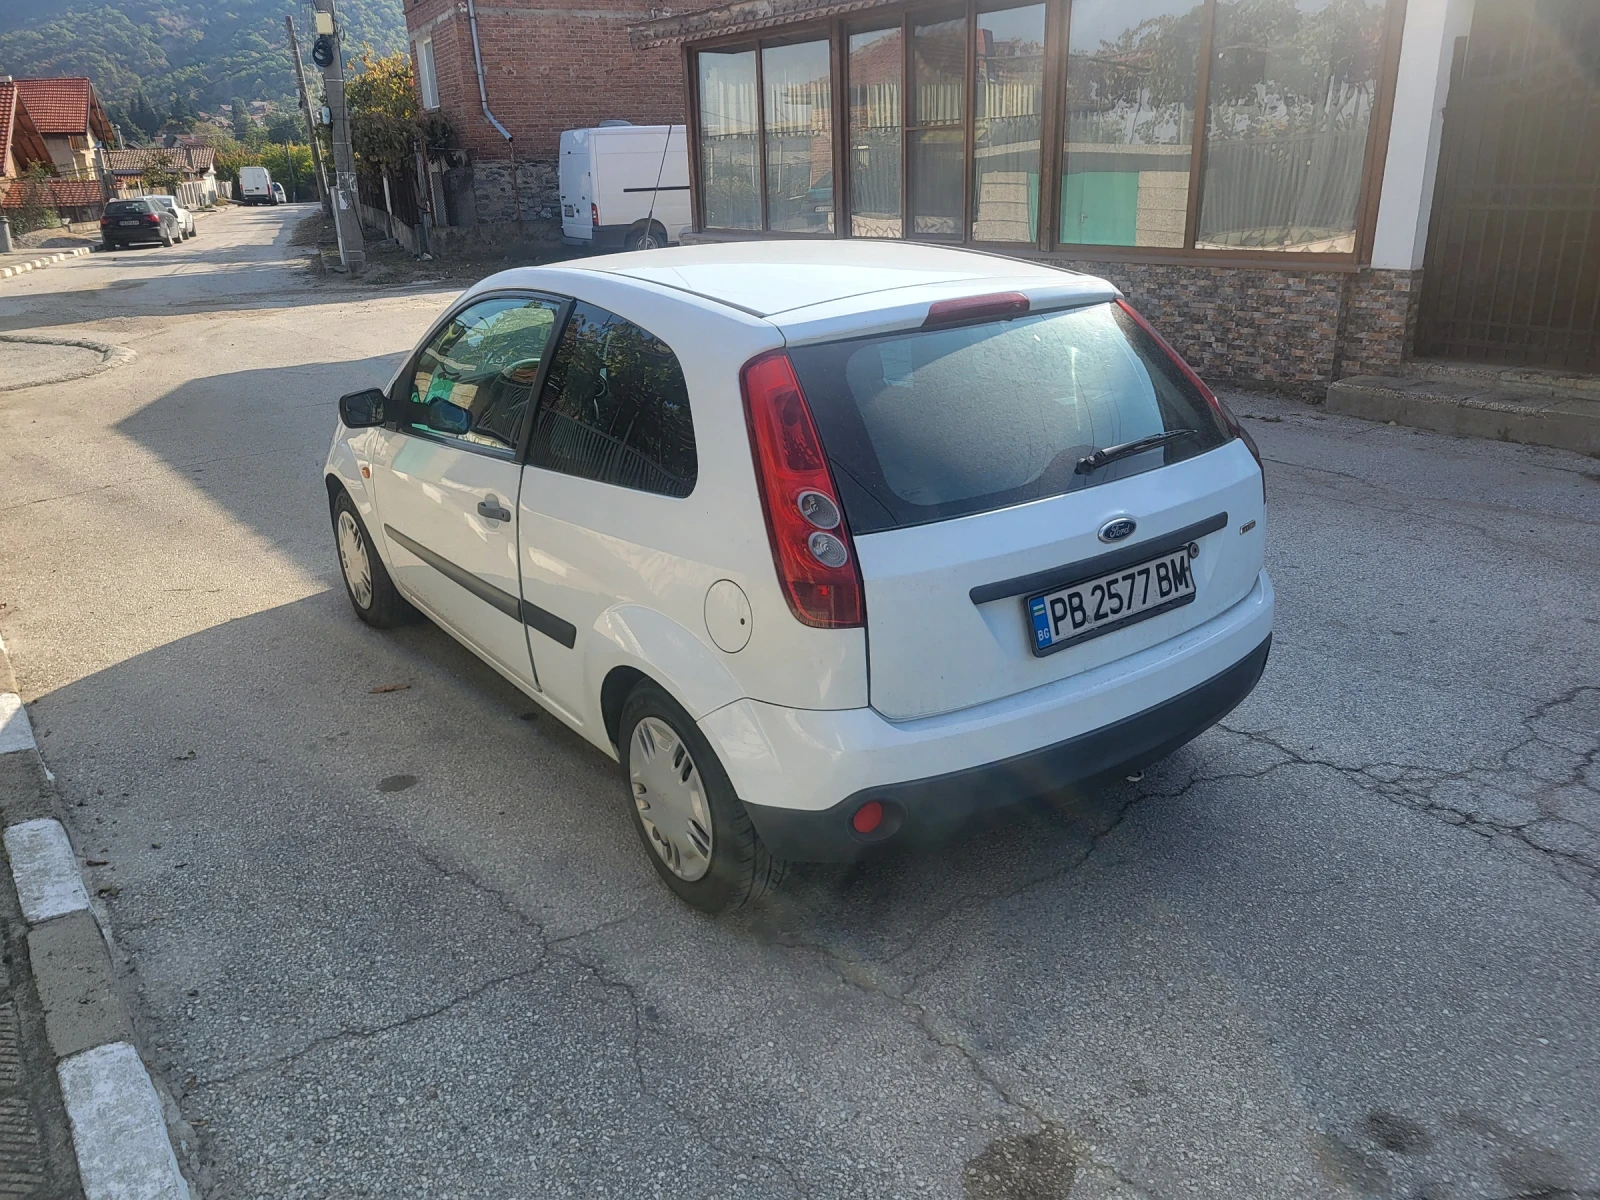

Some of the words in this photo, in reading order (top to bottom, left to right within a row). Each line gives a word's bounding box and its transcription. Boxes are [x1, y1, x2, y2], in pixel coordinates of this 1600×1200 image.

[1110, 522, 1130, 538] Ford
[1049, 591, 1087, 636] PB
[1090, 567, 1151, 622] 2577
[1155, 555, 1190, 599] BM
[1037, 627, 1050, 641] BG
